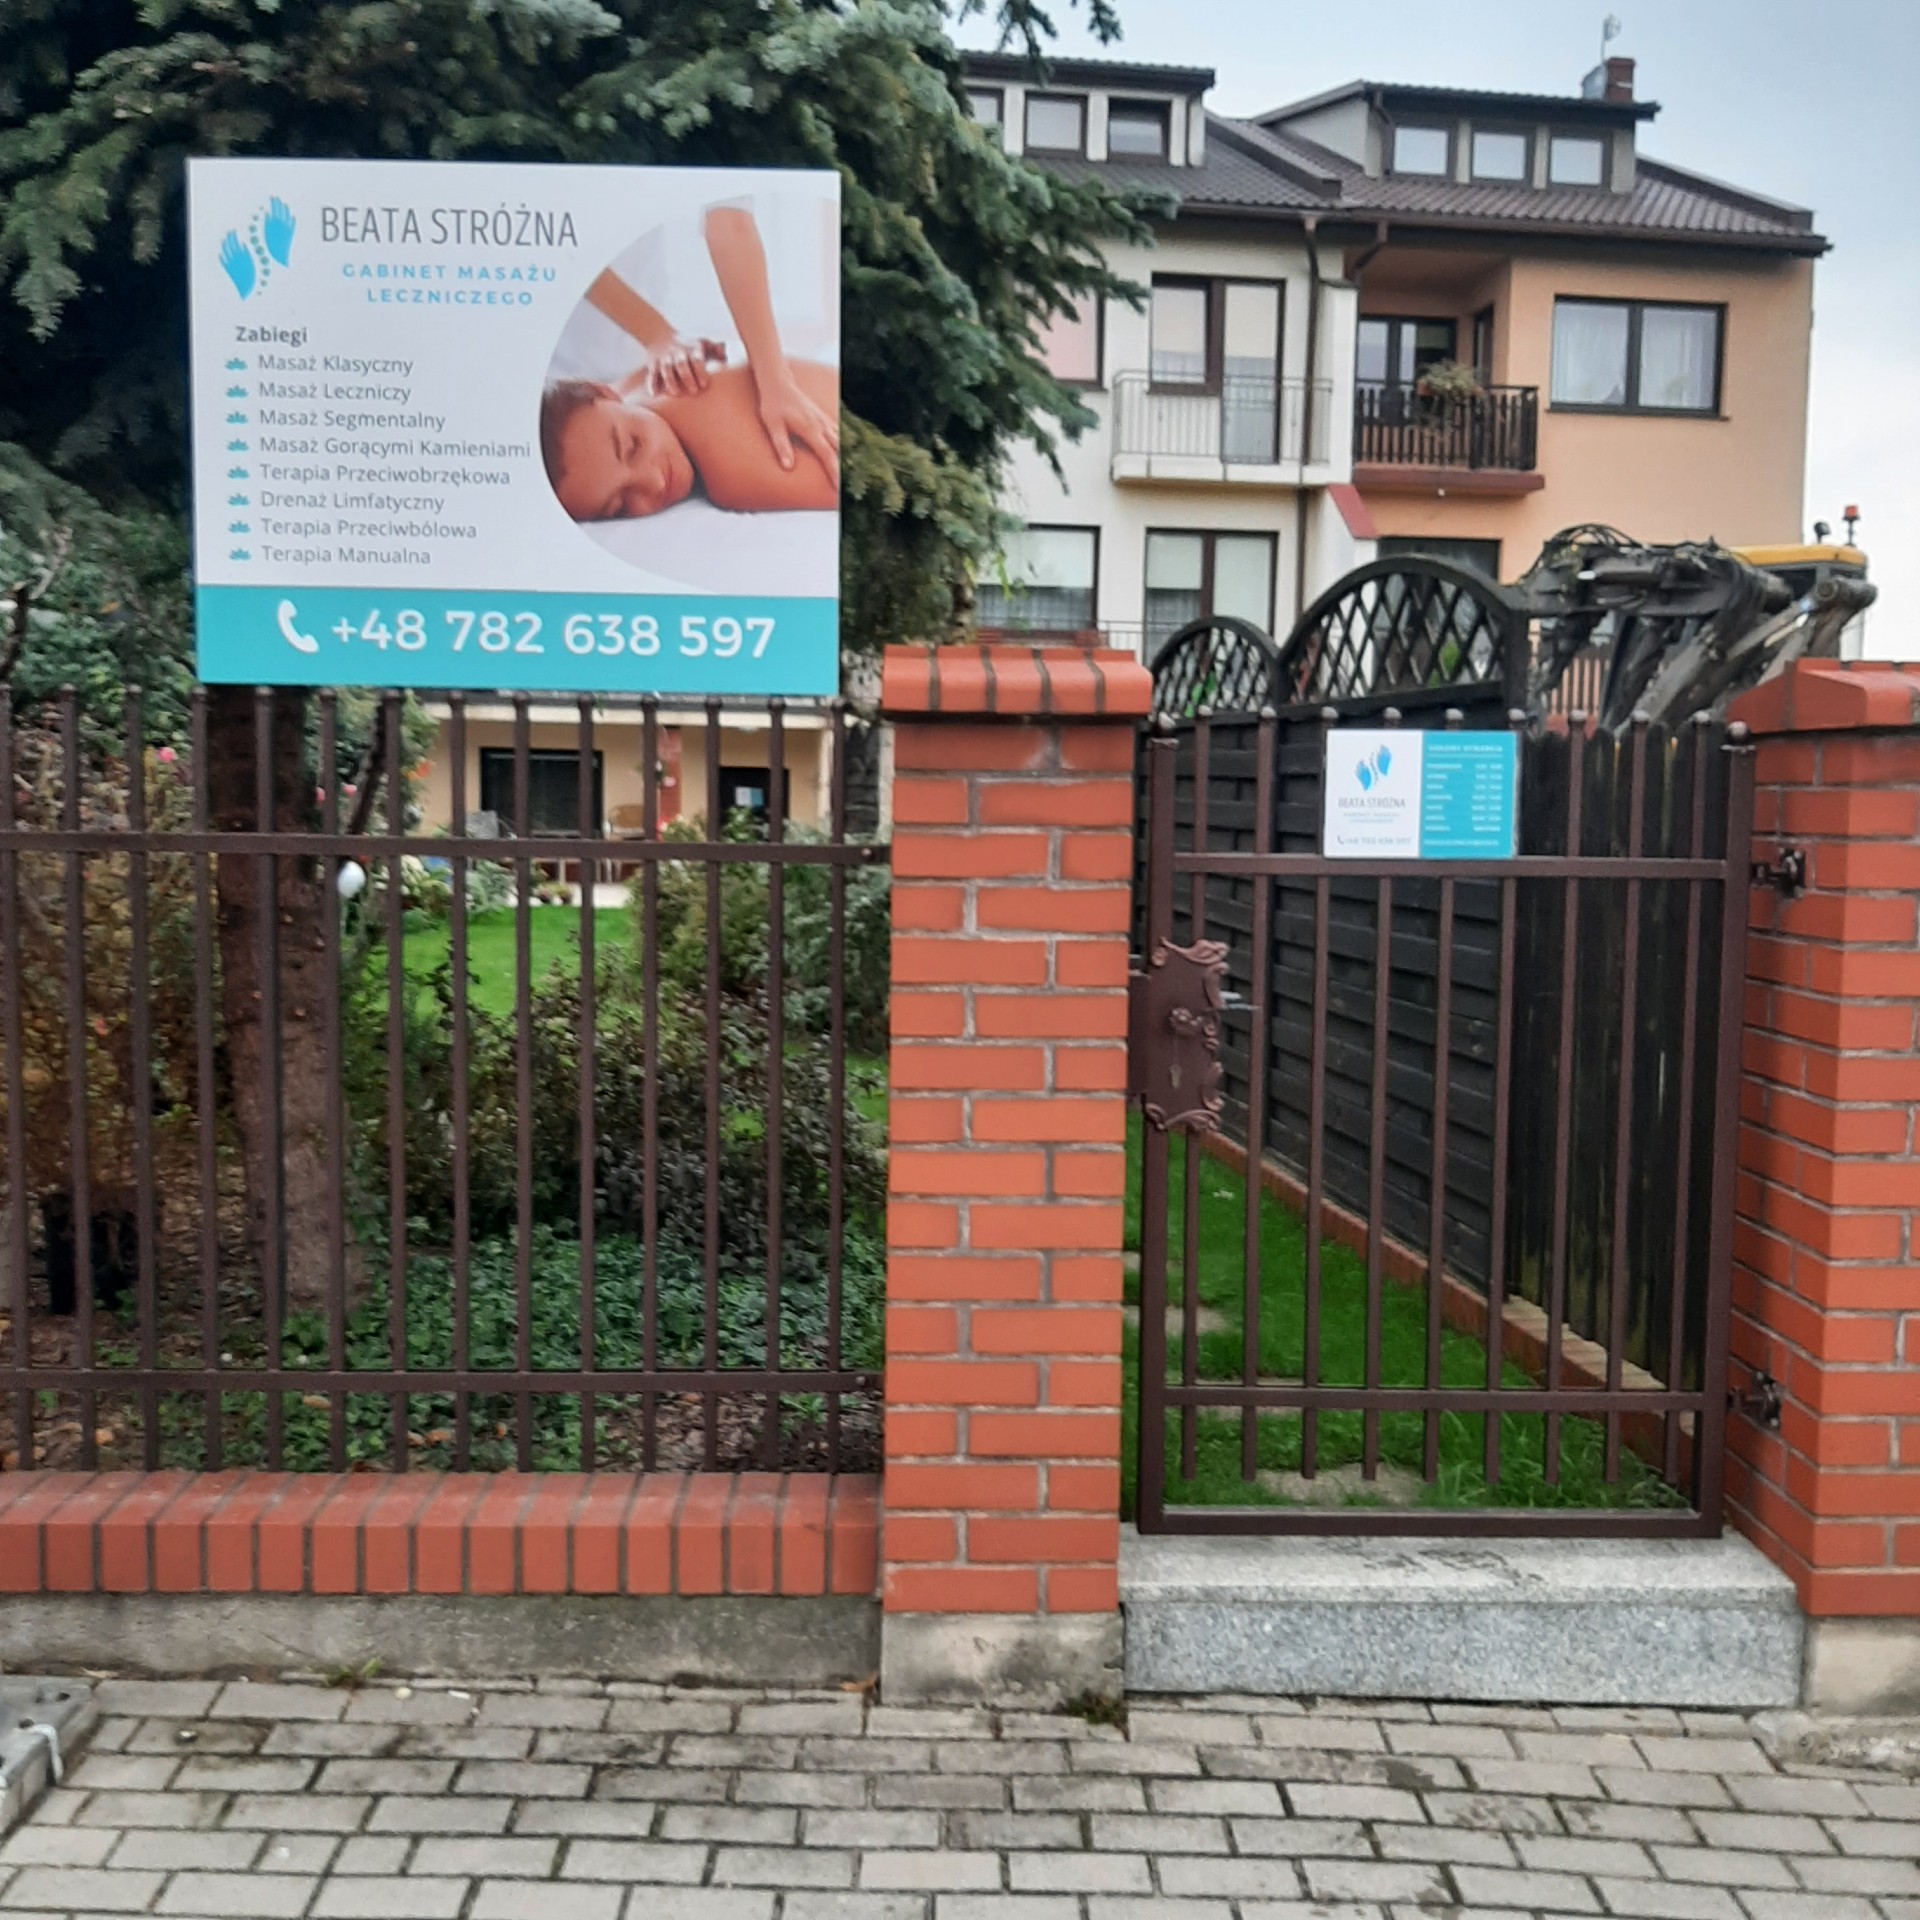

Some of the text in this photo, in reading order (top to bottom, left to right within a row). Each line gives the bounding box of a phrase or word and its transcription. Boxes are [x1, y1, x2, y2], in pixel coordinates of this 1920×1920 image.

[322, 201, 577, 247] BEATA STRÓŻNA
[343, 264, 555, 281] GABINET MASAŻU
[368, 288, 532, 305] LECZNICZEGO
[236, 326, 307, 347] Zabiegi
[259, 354, 413, 377] Masaż Klasyczny
[259, 382, 411, 405] Masaż Leczniczy
[260, 410, 445, 432] Masaż Segmentalny
[260, 437, 530, 459] Masaż Gorącymi Kamieniami
[260, 464, 509, 487] Terapia Przeciwobrzękowa
[261, 491, 444, 514] Drenaż Limfatyczny
[261, 518, 476, 538] Terapia Przeciwbólowa
[262, 545, 430, 566] Terapia Manualna
[333, 609, 775, 657] +48 782 638 597
